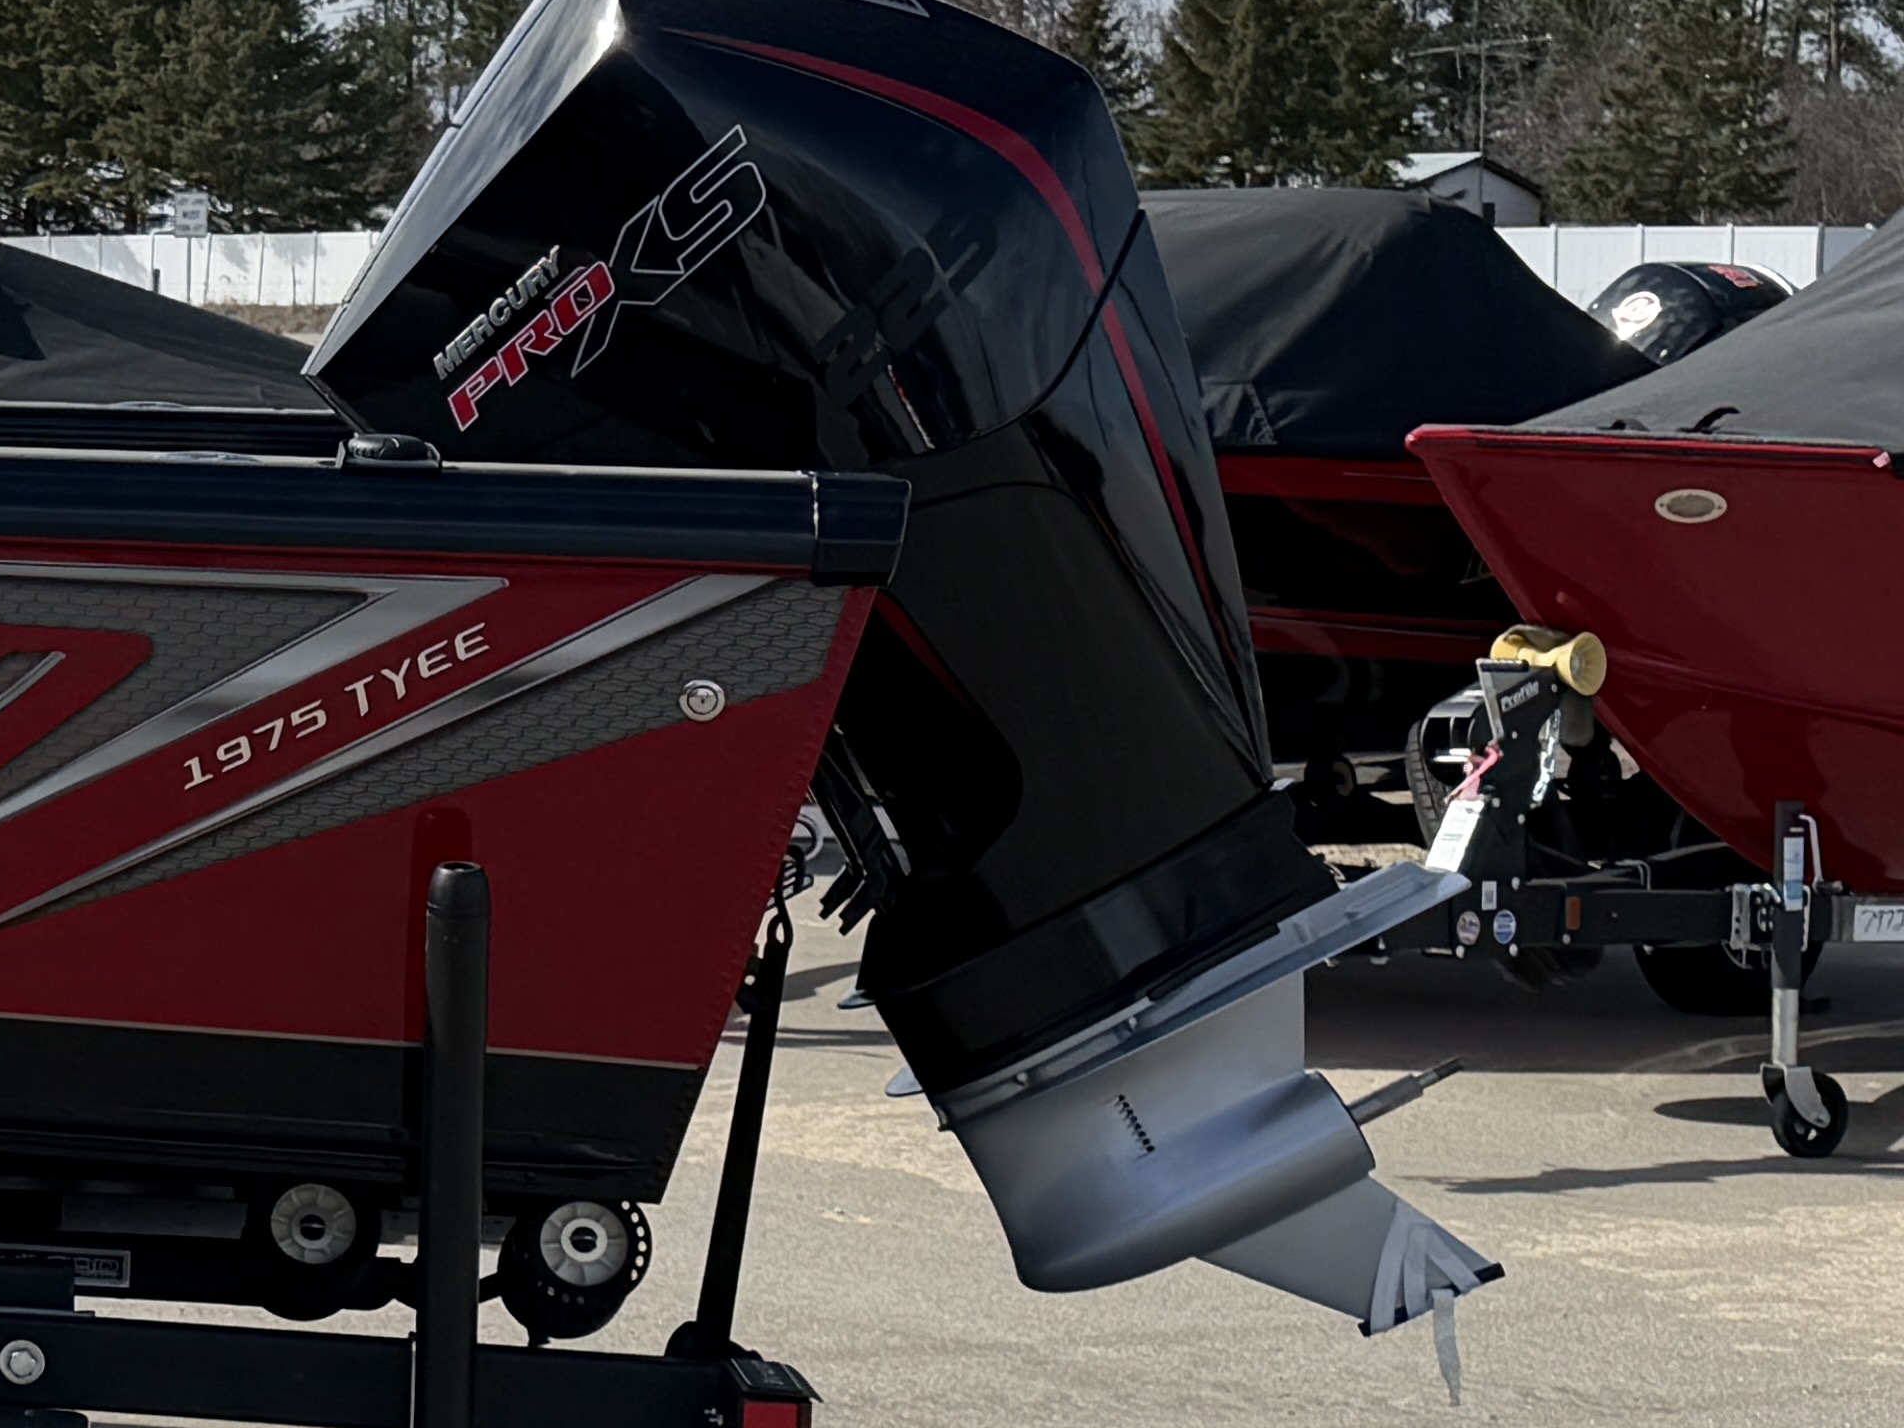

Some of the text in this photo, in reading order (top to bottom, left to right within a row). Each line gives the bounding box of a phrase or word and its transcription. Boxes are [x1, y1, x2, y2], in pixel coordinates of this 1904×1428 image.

[433, 244, 562, 380] MERCURY
[184, 622, 492, 791] 1975 TYEE
